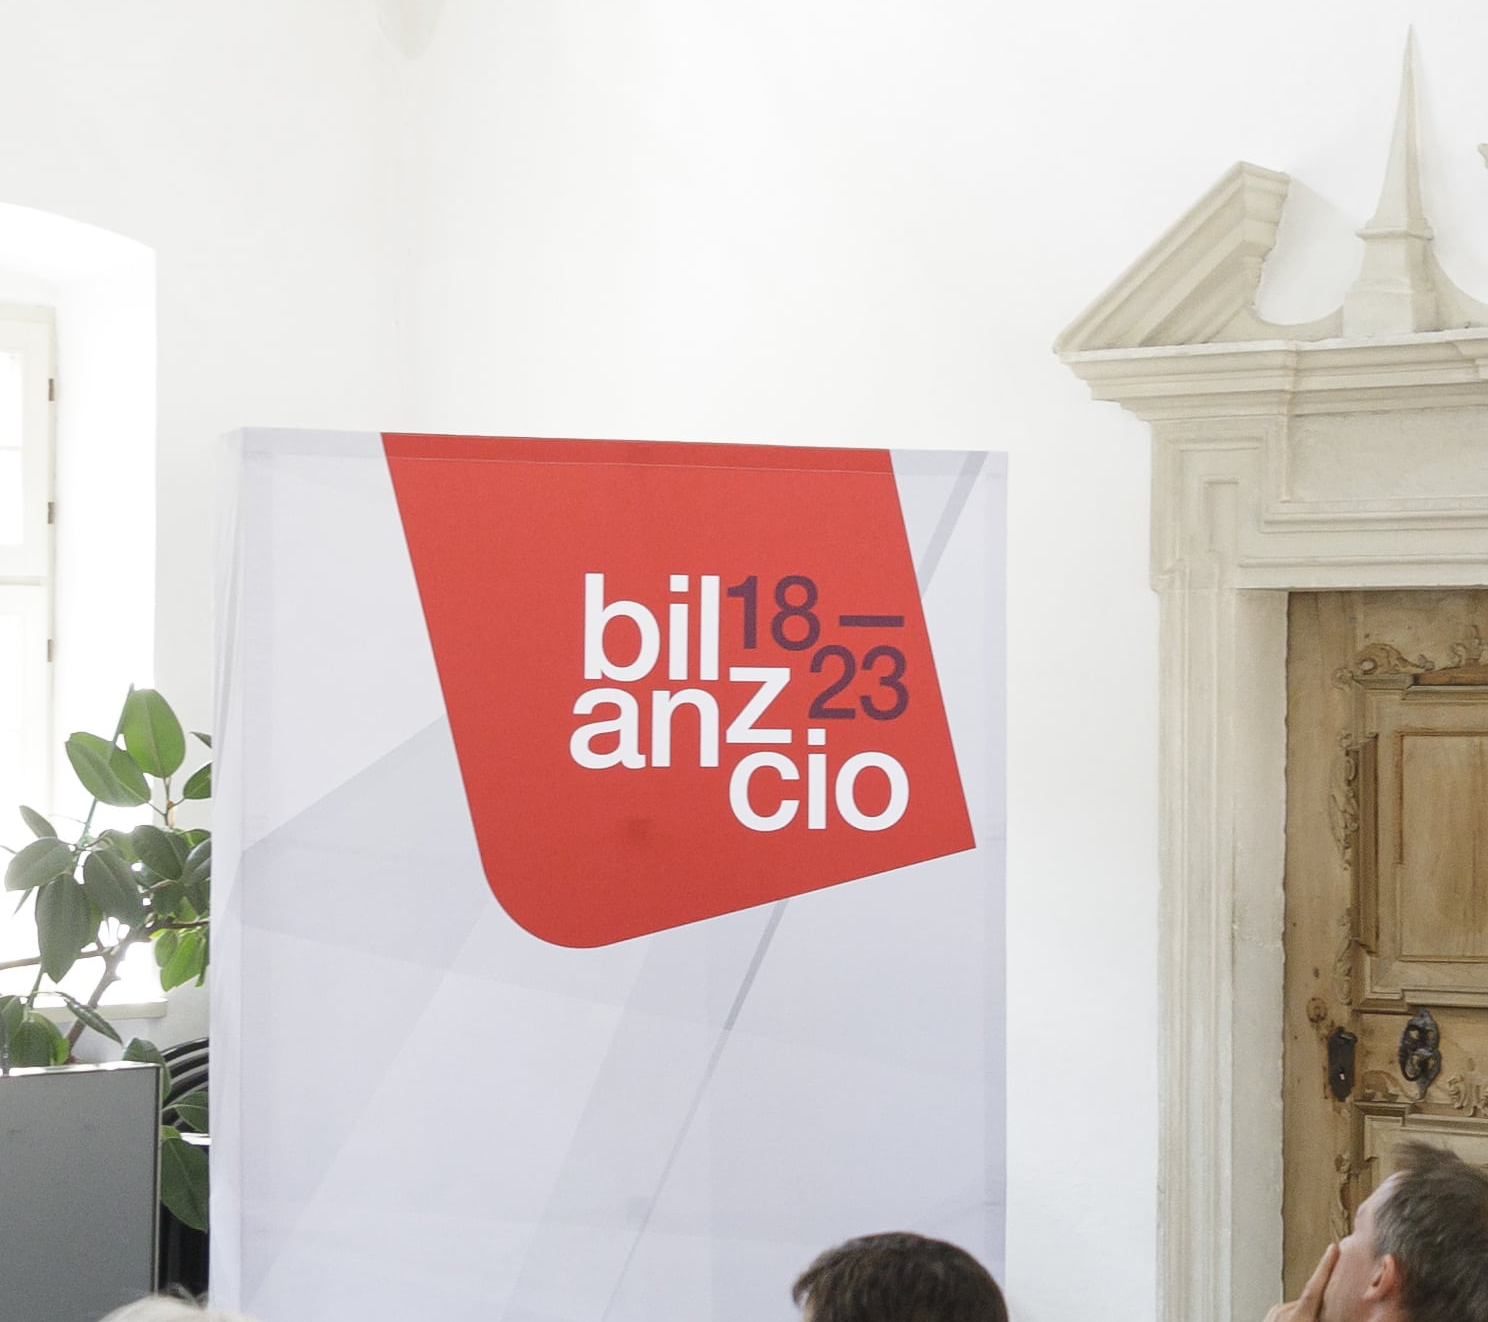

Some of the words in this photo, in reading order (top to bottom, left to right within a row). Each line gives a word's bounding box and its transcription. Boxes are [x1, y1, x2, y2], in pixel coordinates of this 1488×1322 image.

[584, 572, 720, 682] bil
[807, 644, 910, 722] 23
[729, 728, 909, 832] cio
